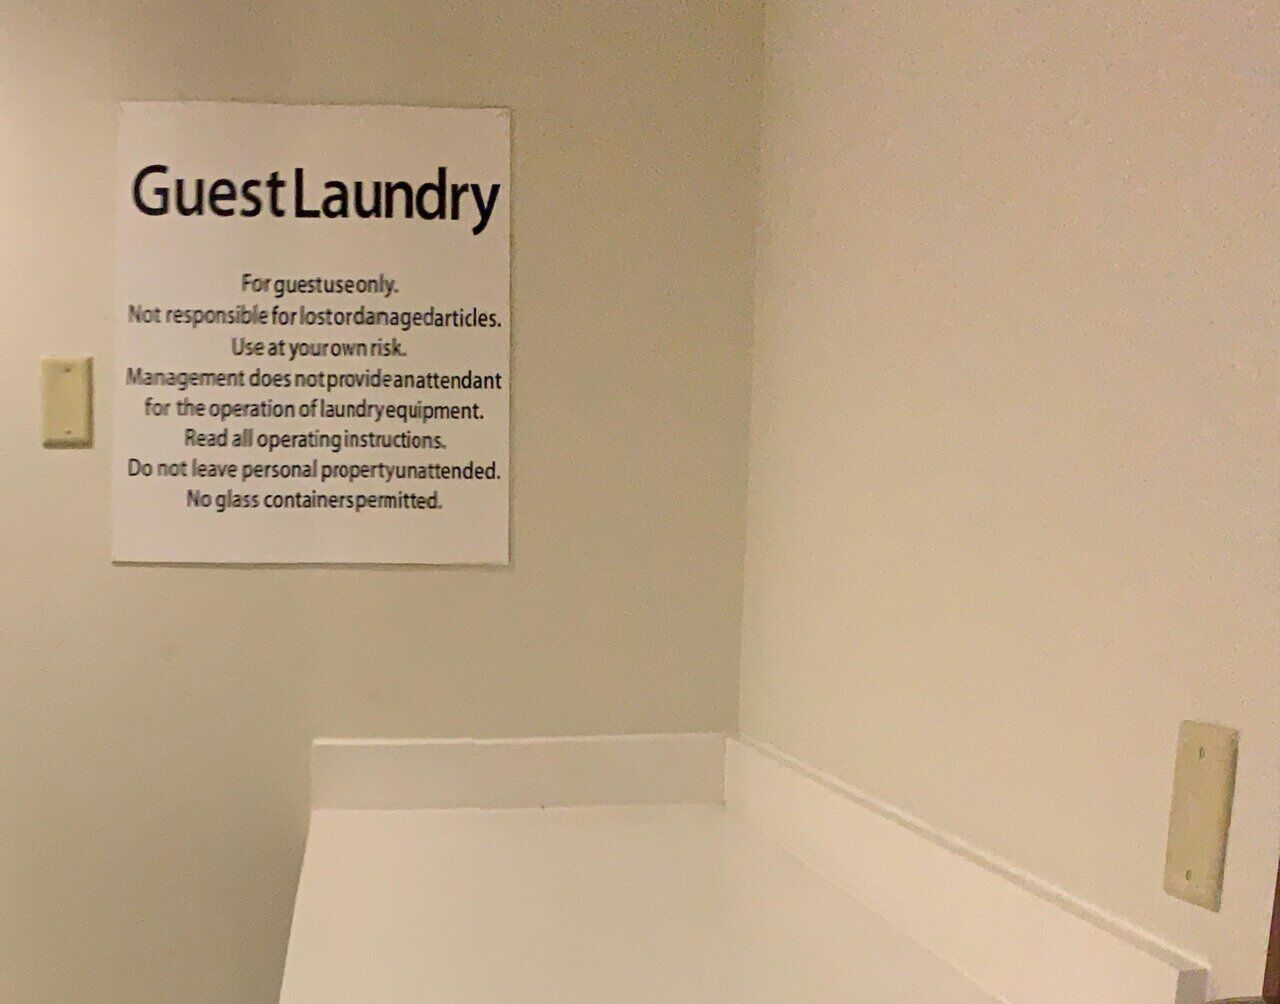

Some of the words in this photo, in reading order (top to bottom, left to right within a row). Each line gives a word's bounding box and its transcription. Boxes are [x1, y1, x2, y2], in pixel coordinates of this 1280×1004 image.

[132, 164, 286, 218] Guest
[294, 166, 501, 235] Laundry
[241, 273, 272, 293] For
[274, 276, 322, 298] guest
[324, 278, 355, 293] use
[355, 273, 400, 298] only.
[127, 304, 162, 324] Not
[165, 304, 268, 329] responsible
[272, 305, 298, 325] for
[299, 305, 333, 325] lost
[334, 310, 352, 325] or
[434, 307, 502, 328] articles.
[231, 337, 264, 356] Use
[267, 340, 286, 356] at
[289, 342, 329, 361] your
[330, 342, 368, 356] own
[370, 338, 408, 356] risk.
[125, 367, 245, 391] Management
[249, 368, 291, 387] does
[294, 371, 324, 387] not
[326, 369, 392, 392] provide
[393, 373, 415, 389] an
[416, 370, 502, 390] attendant
[144, 397, 171, 416] for
[176, 397, 206, 416] the
[208, 399, 296, 421] operation
[298, 398, 318, 417] of
[320, 398, 385, 422] laundry
[385, 401, 484, 424] equipment.
[184, 428, 228, 447] Read
[231, 428, 254, 447] all
[256, 429, 341, 452] operating
[344, 430, 447, 449] instructions.
[127, 458, 153, 477] Do
[156, 461, 188, 477] not
[191, 458, 238, 477] leave
[241, 458, 318, 482] personal
[321, 462, 396, 482] property
[395, 460, 501, 480] unattended.
[186, 489, 212, 507] No
[215, 489, 259, 513] glass
[263, 490, 353, 508] containers
[354, 491, 443, 512] permitted.
